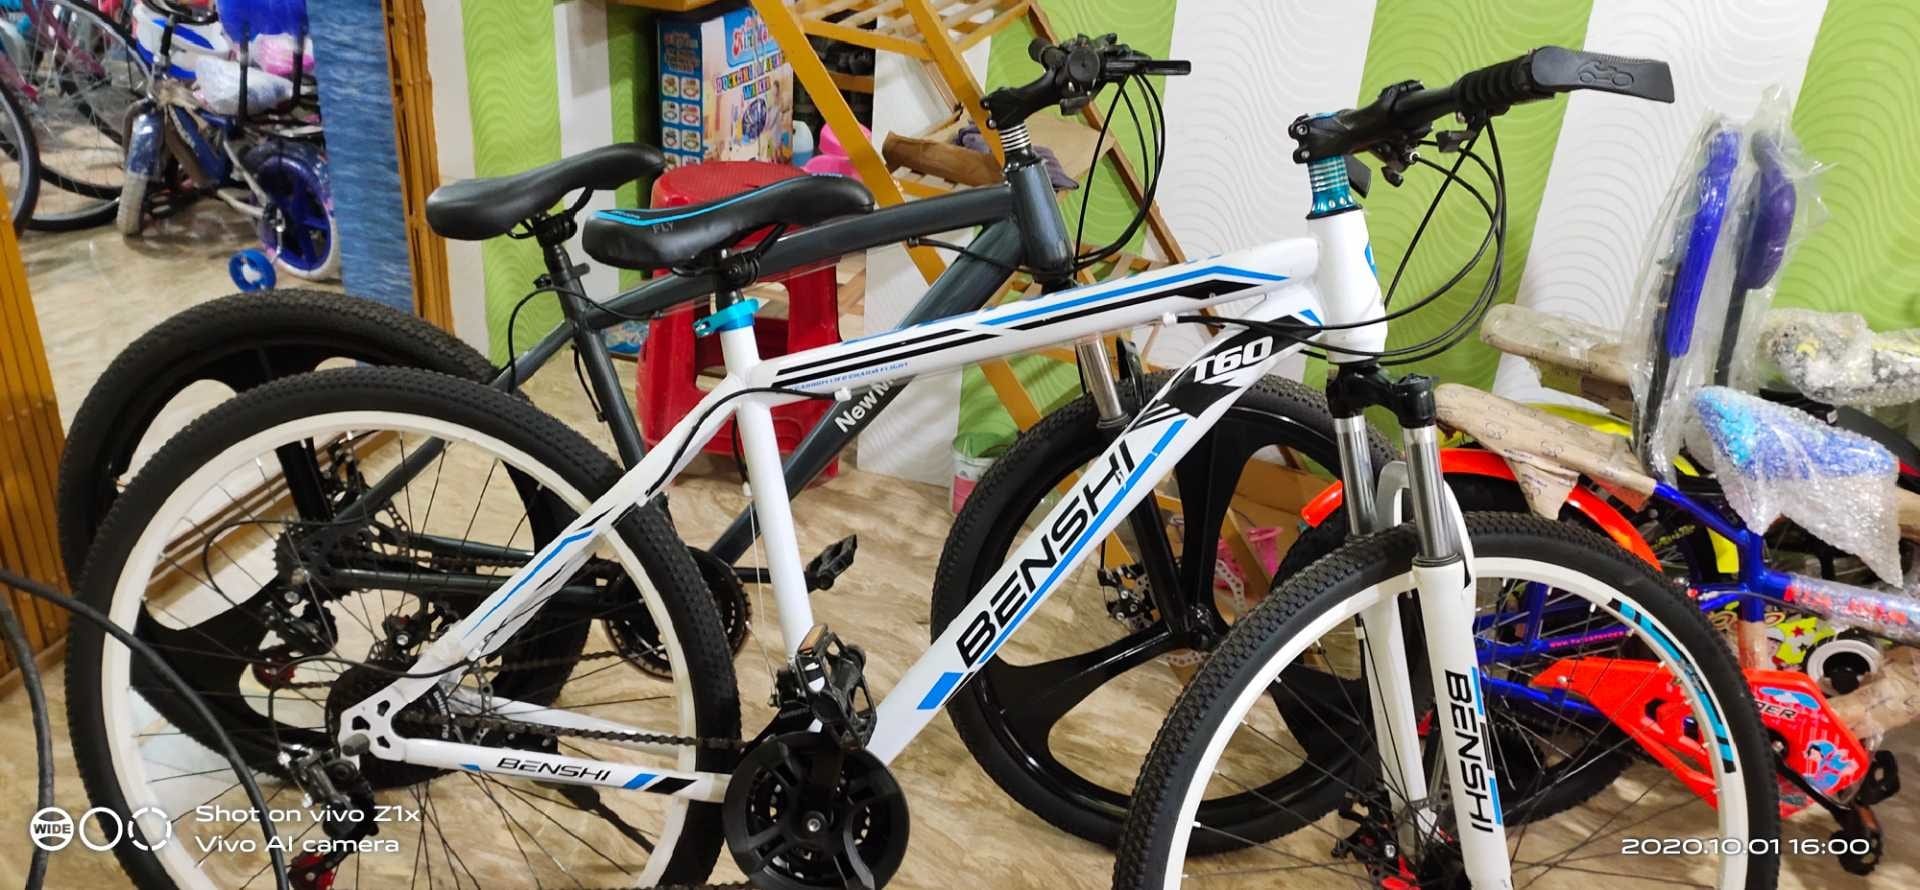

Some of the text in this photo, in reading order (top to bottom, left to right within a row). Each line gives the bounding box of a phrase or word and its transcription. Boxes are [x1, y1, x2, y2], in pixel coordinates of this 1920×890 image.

[652, 223, 676, 235] FLY
[1194, 336, 1274, 383] T60
[956, 440, 1135, 669] BENSHI
[497, 757, 611, 782] BENSHI
[1445, 669, 1494, 833] BENSHI
